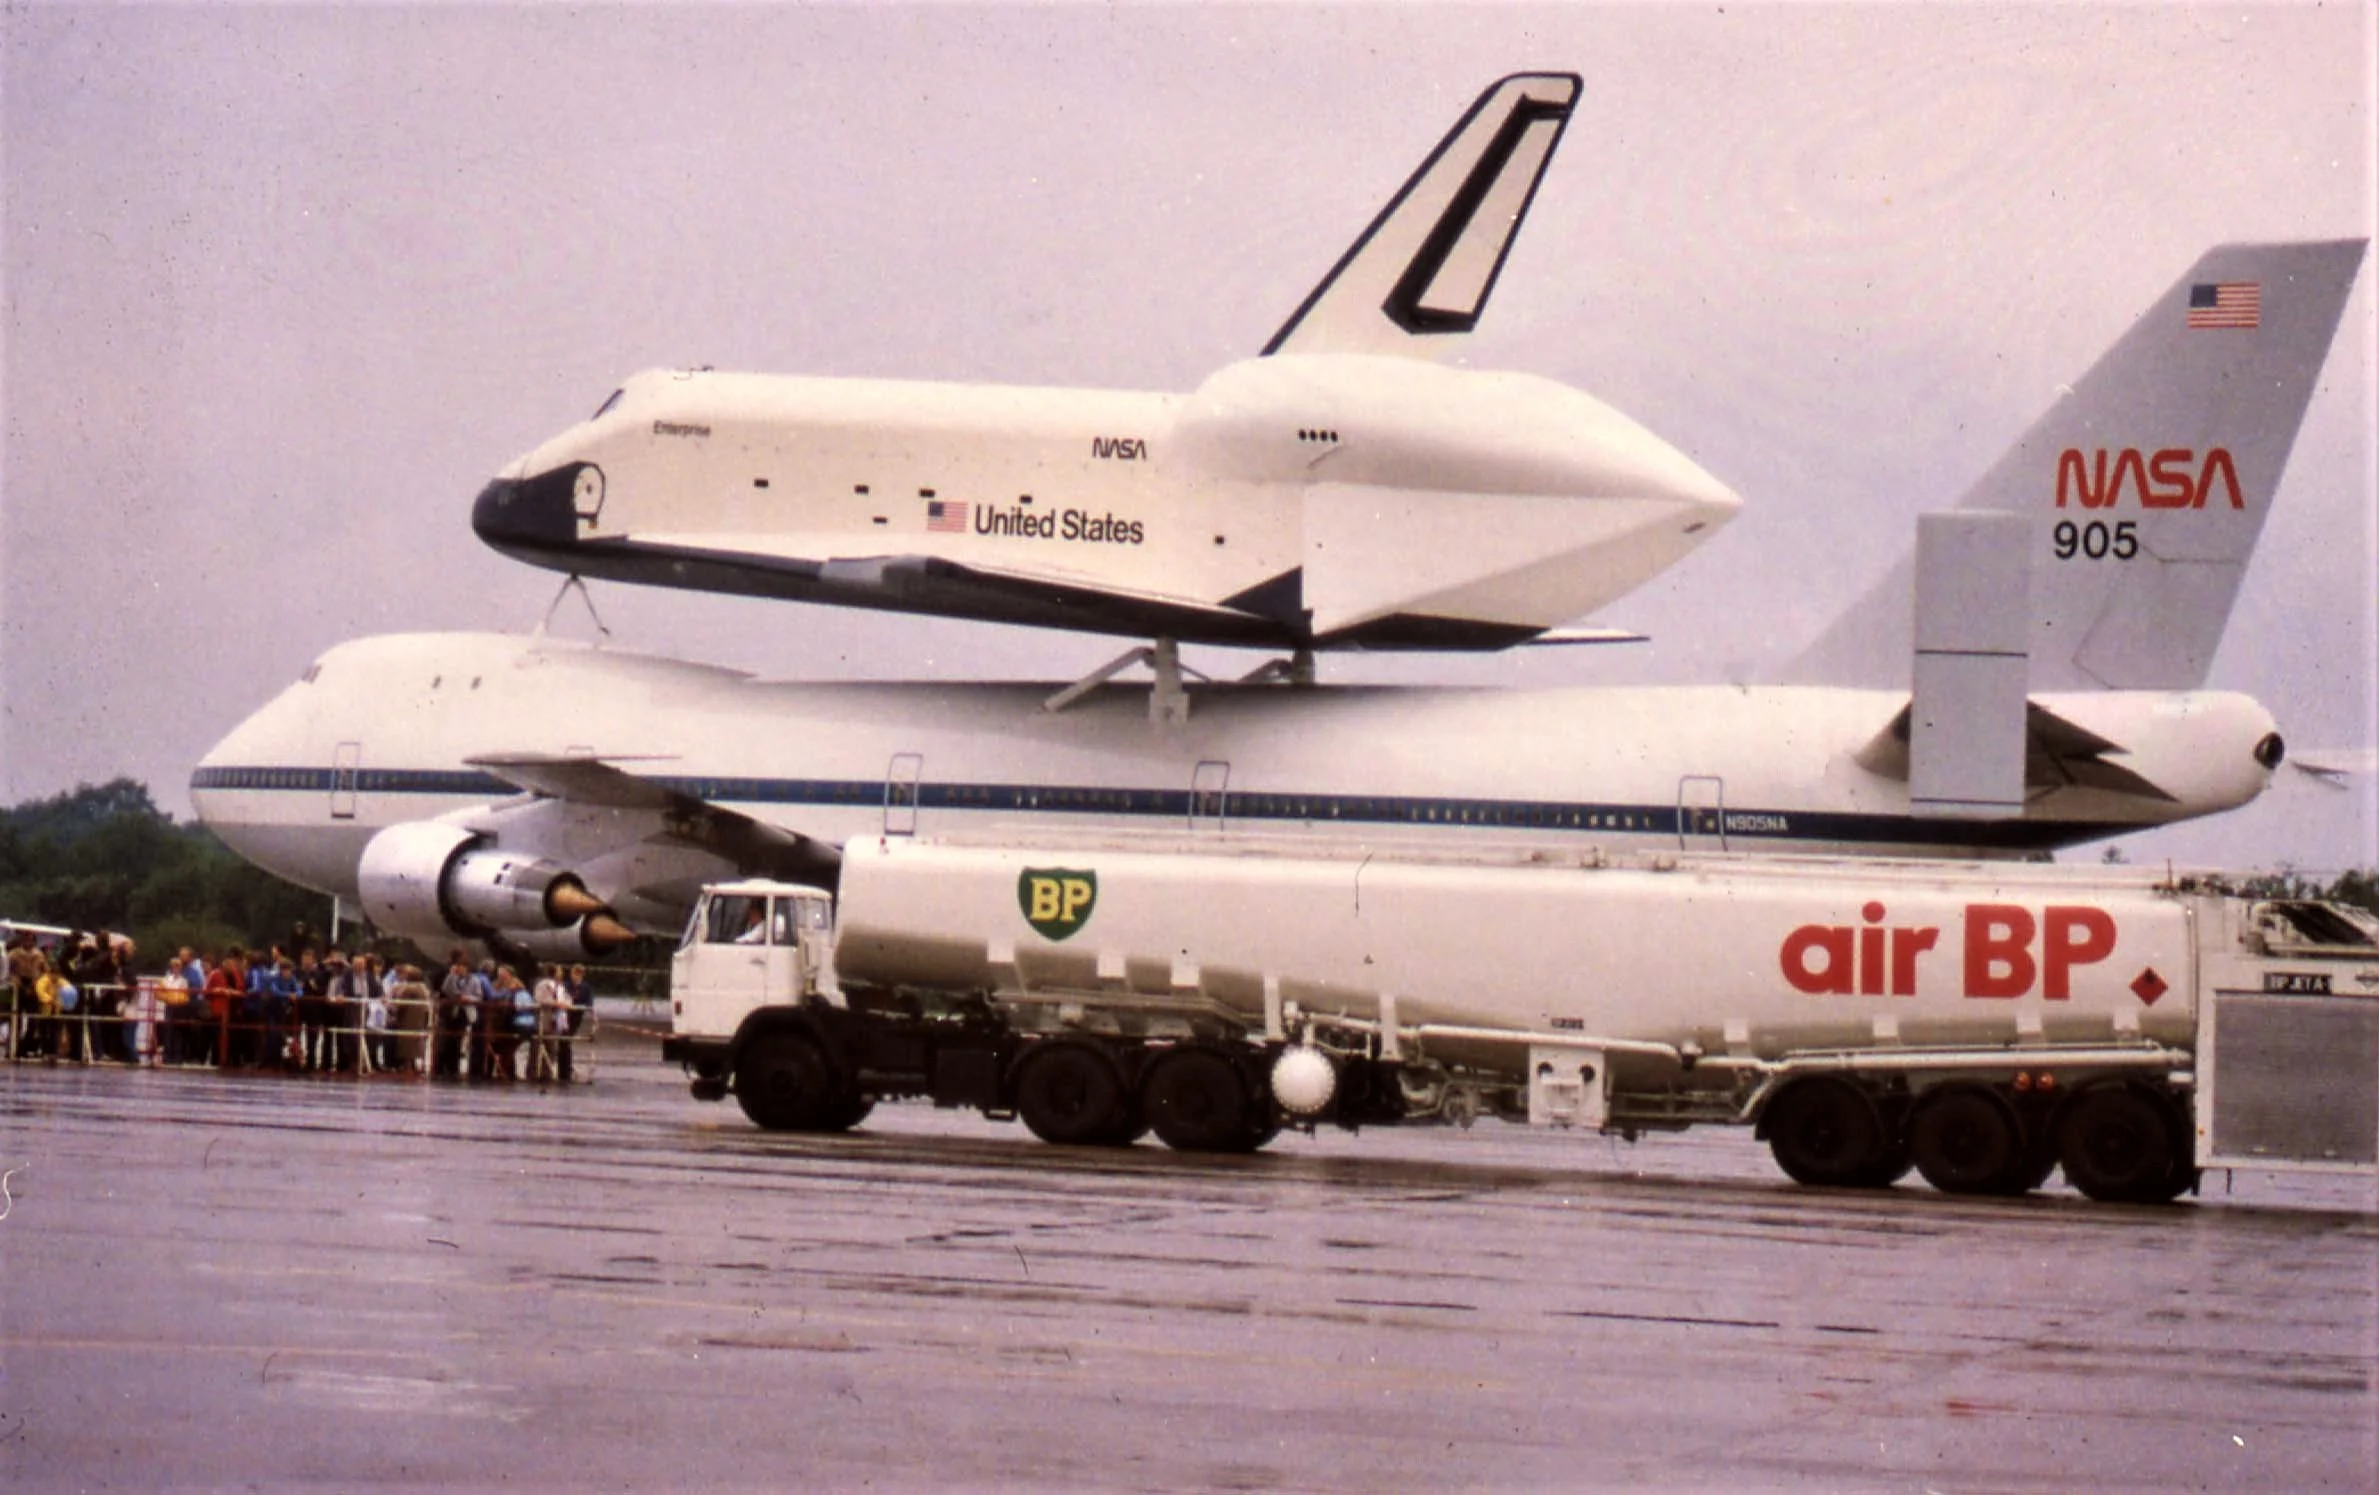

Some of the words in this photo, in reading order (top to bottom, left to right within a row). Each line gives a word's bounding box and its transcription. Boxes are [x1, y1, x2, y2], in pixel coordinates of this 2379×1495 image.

[653, 419, 711, 438] Enterprise
[1092, 436, 1147, 461] NASA
[2055, 447, 2246, 509] NASA
[975, 503, 1056, 538] United
[1061, 508, 1144, 544] States
[2053, 520, 2139, 560] 905
[1726, 815, 1788, 832] N905NA
[1030, 877, 1092, 921] BP
[1779, 901, 1940, 997] air
[1963, 904, 2117, 1001] BP
